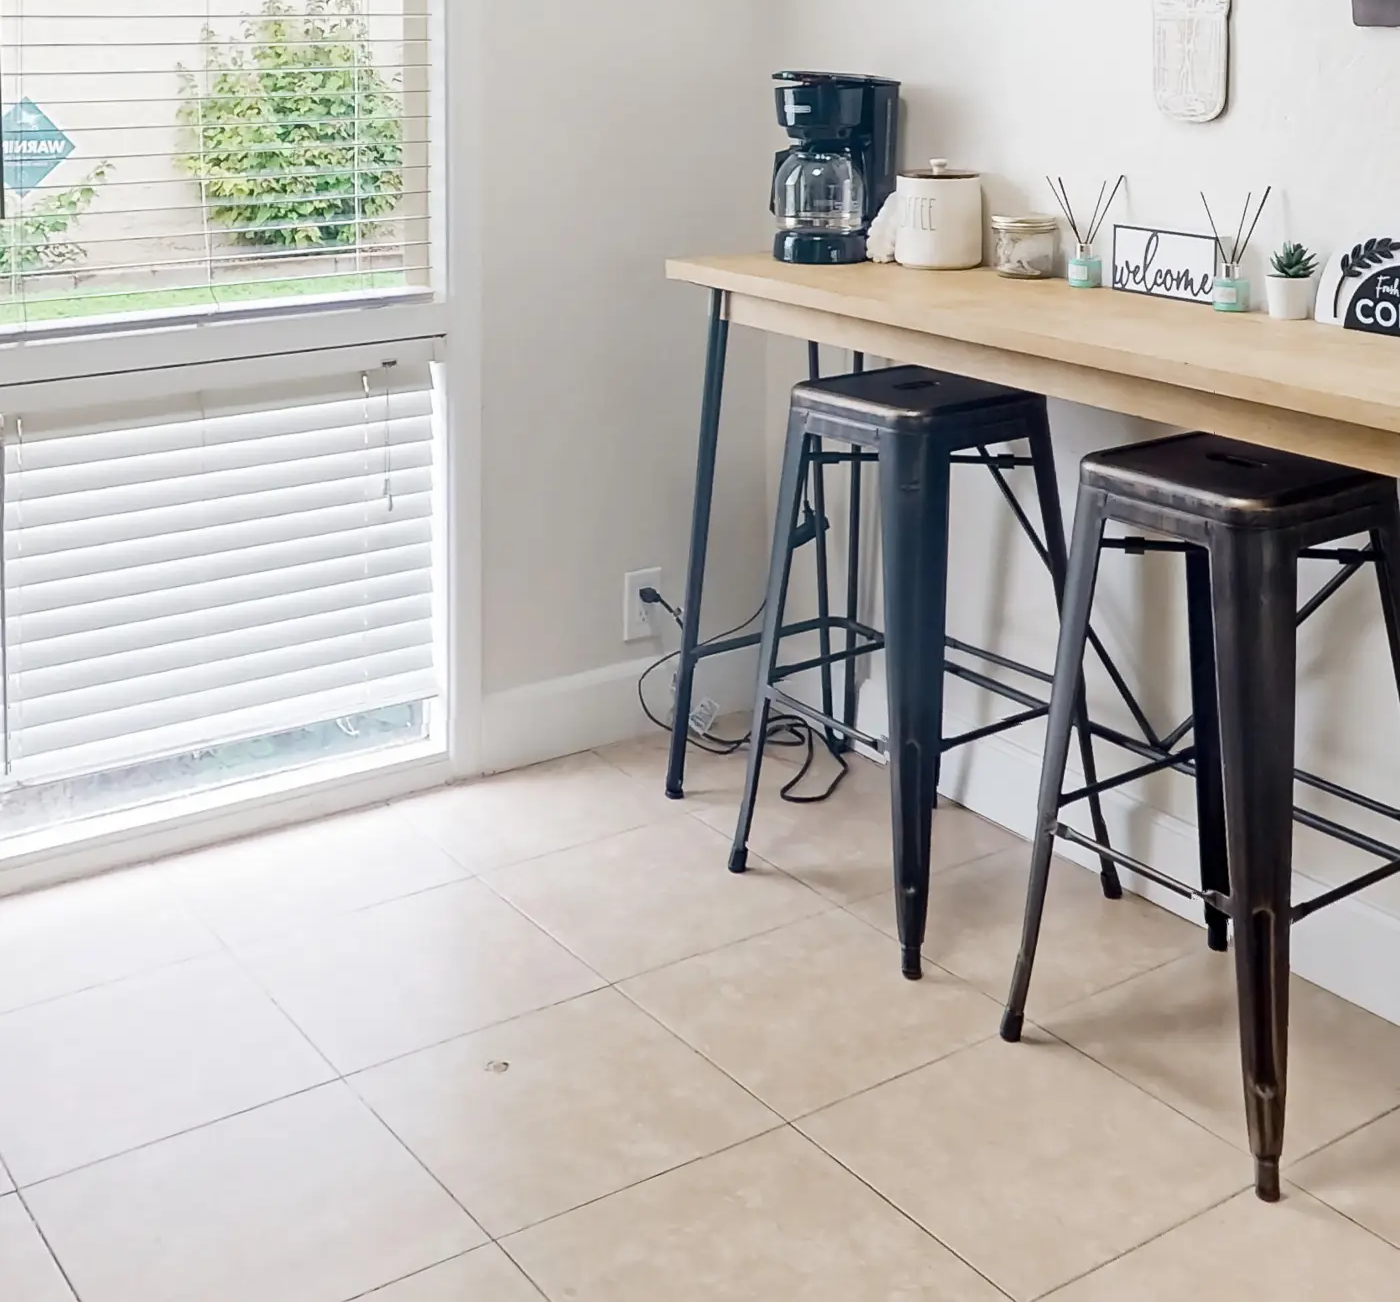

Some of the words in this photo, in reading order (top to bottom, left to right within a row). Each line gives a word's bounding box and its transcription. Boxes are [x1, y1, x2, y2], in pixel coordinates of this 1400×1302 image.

[899, 196, 937, 232] FFEE
[1114, 231, 1213, 296] welcome
[1355, 298, 1400, 329] CO
